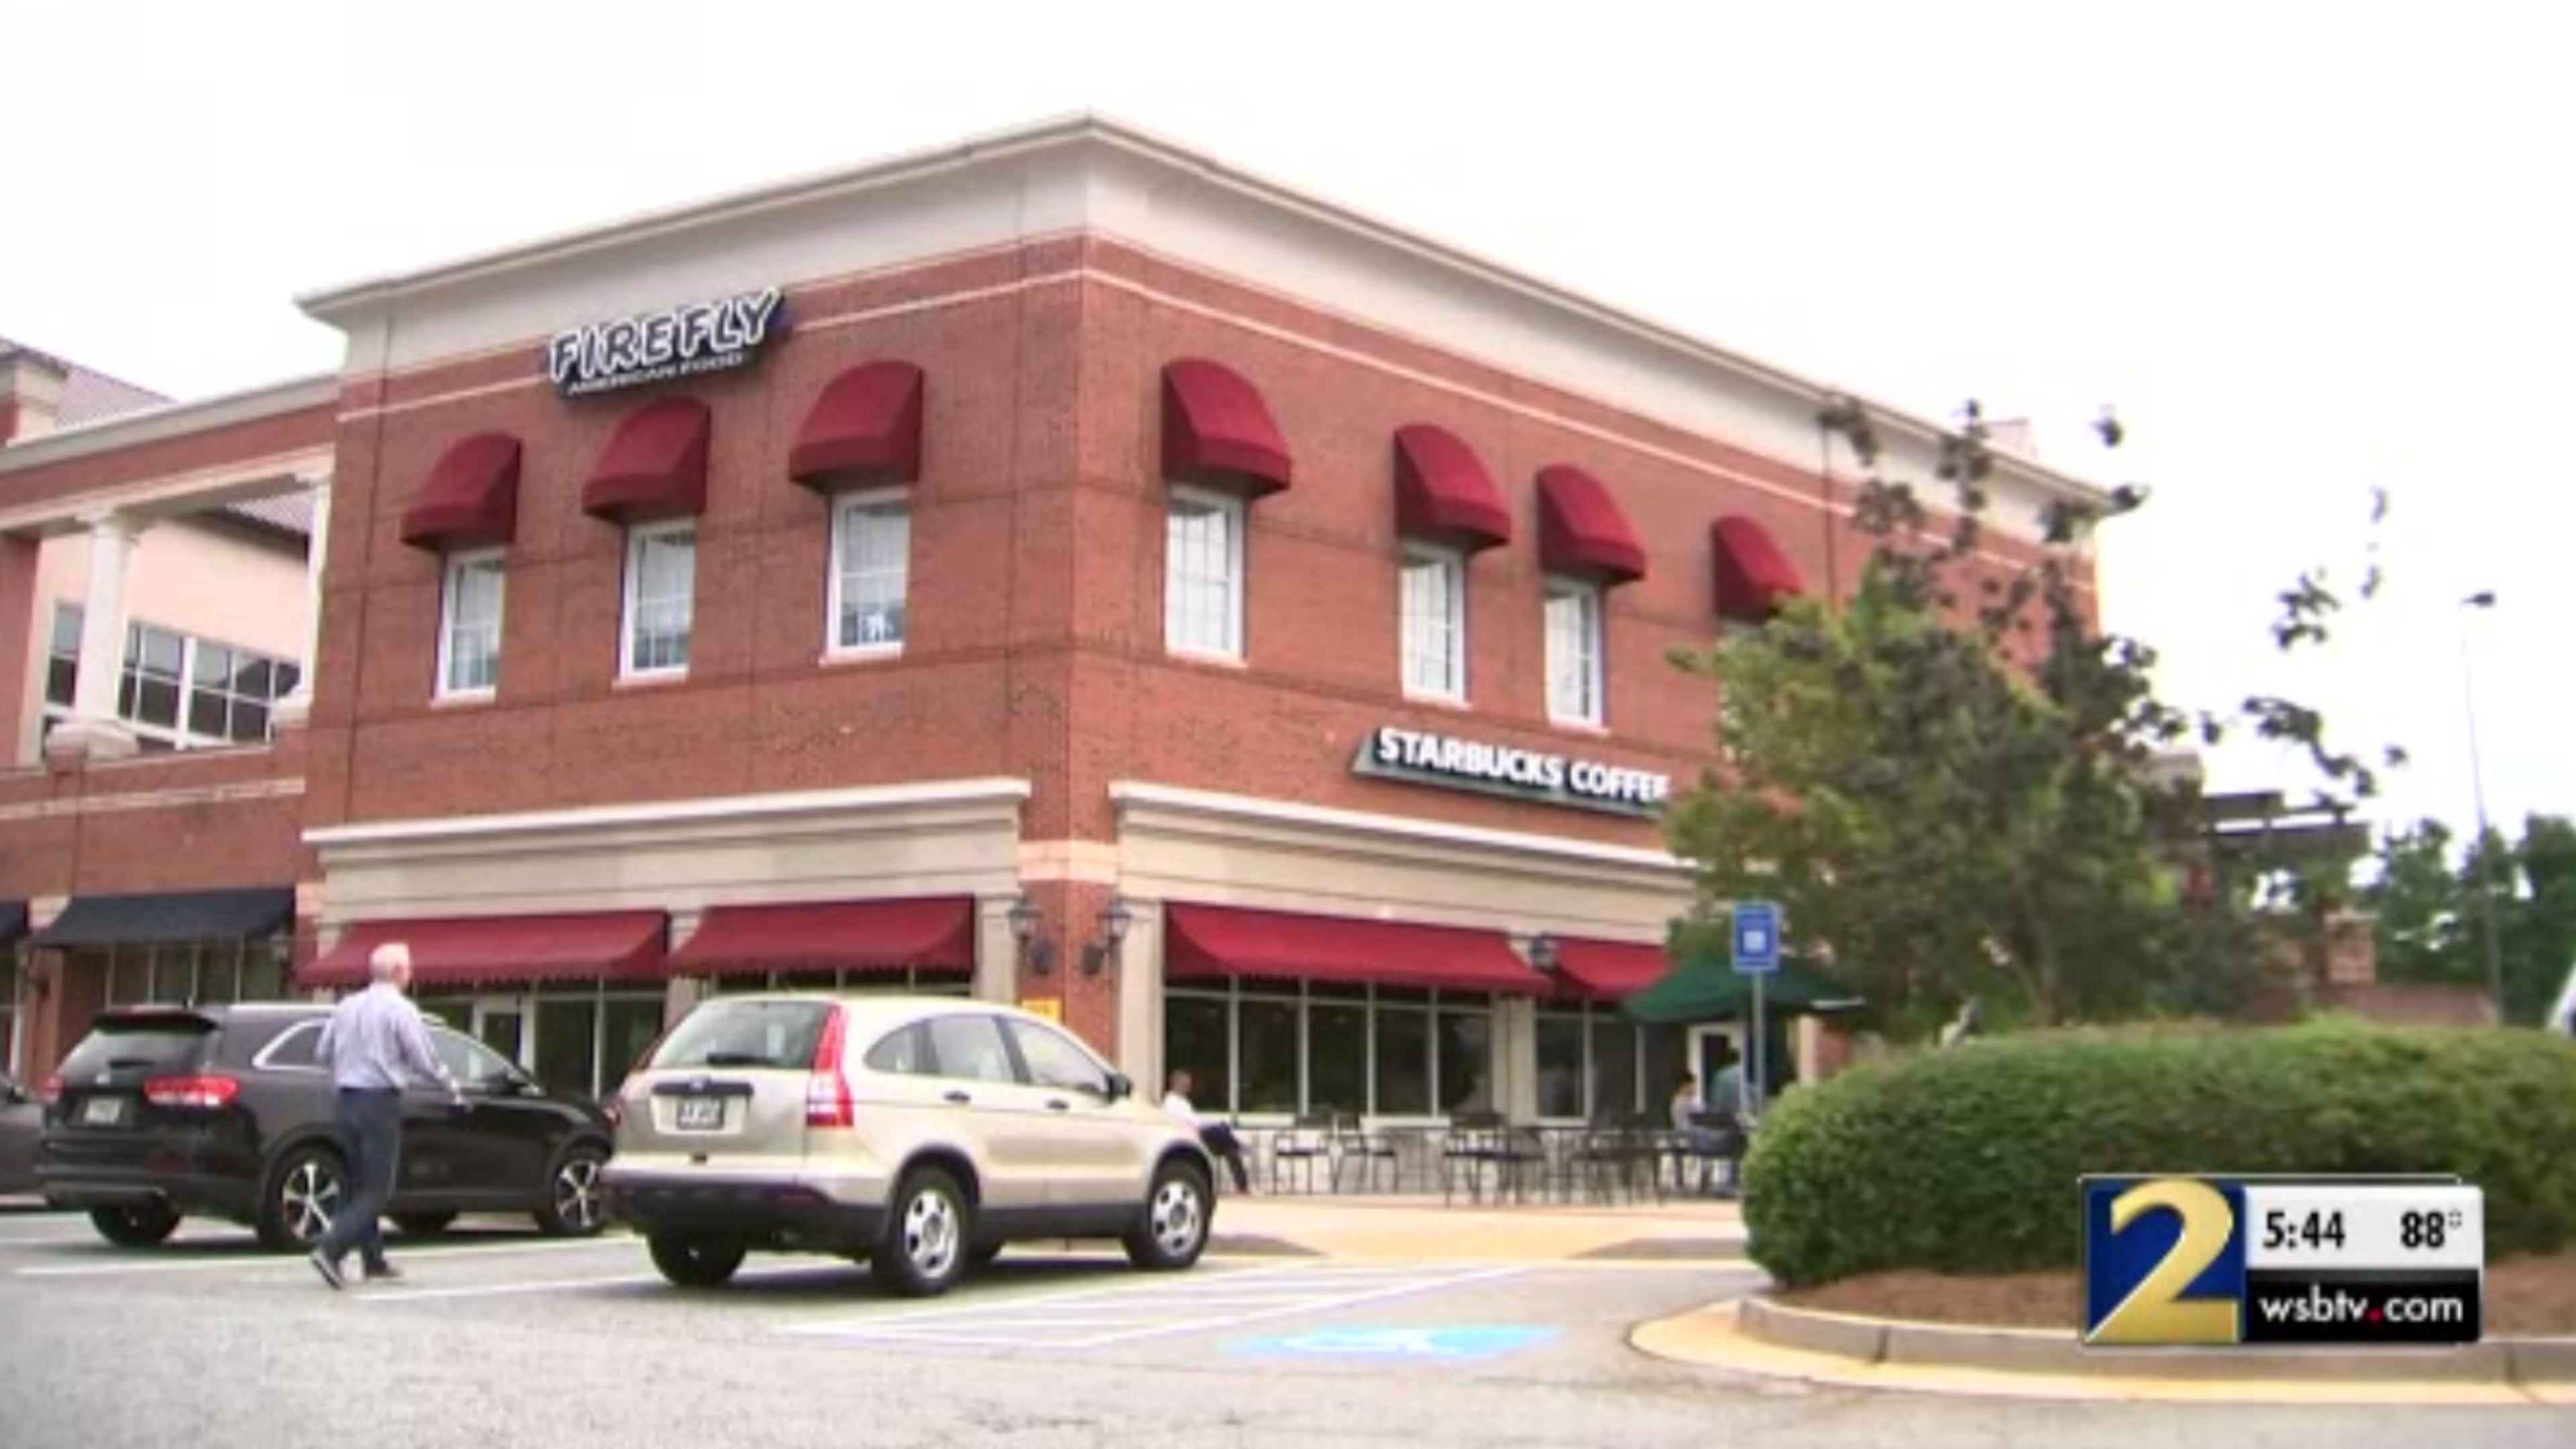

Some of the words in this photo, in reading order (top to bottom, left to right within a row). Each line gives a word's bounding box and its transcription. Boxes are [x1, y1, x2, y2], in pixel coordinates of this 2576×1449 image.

[549, 286, 781, 384] FIREFLY
[568, 366, 676, 396] AMERICAN
[1379, 727, 1563, 786] STARBUCKS
